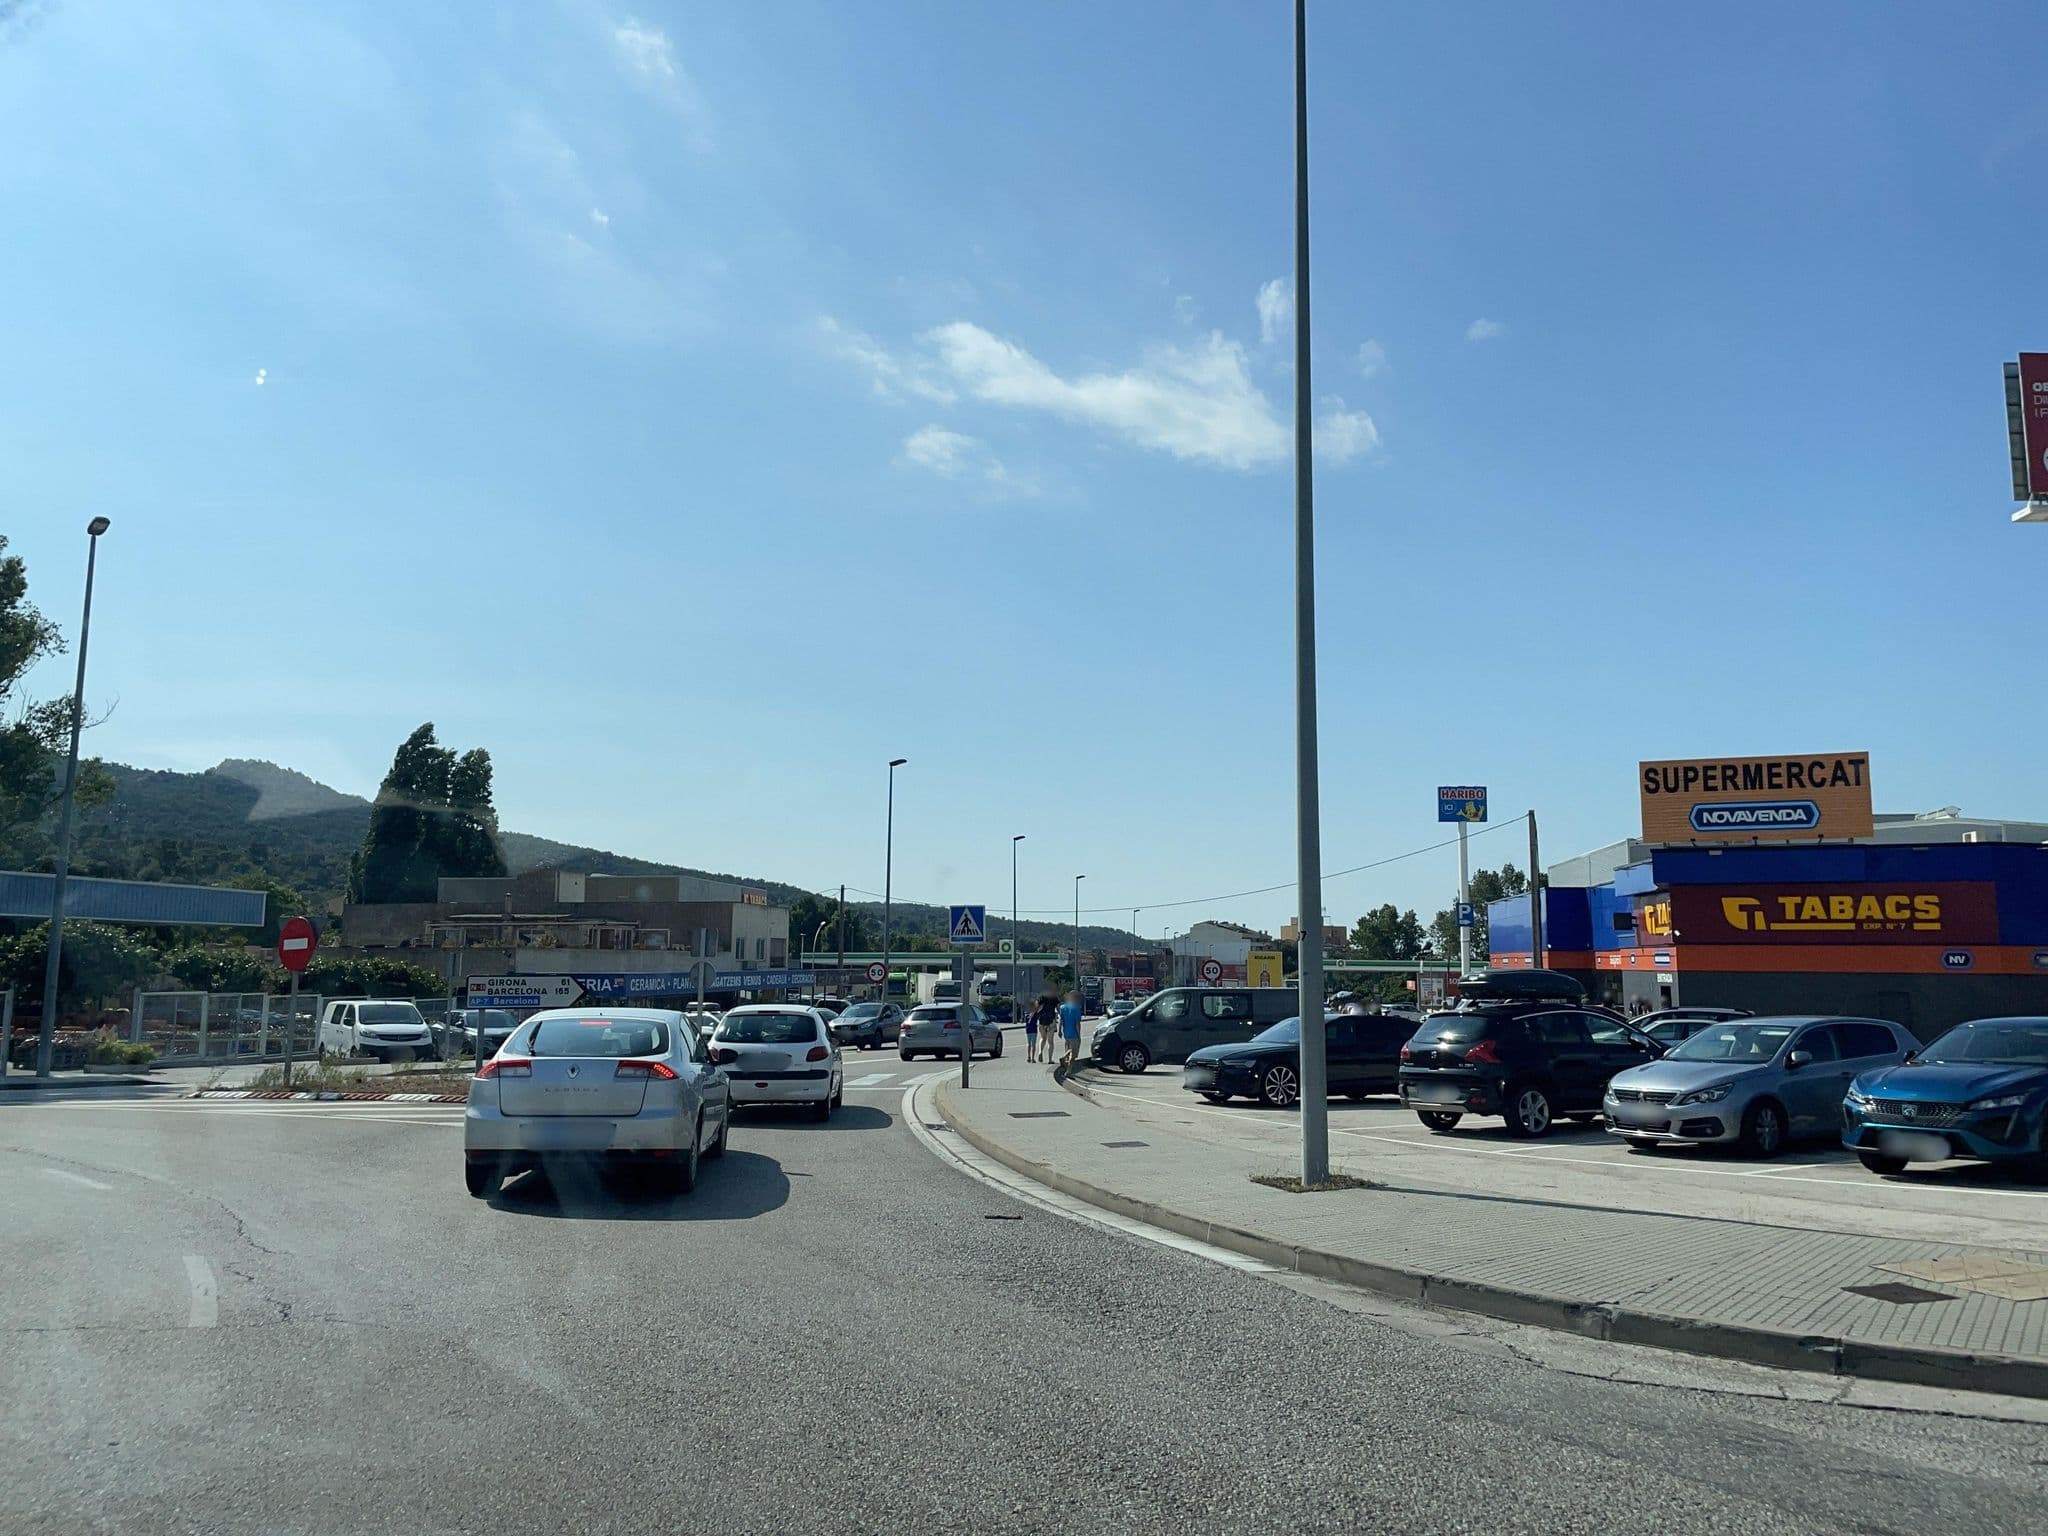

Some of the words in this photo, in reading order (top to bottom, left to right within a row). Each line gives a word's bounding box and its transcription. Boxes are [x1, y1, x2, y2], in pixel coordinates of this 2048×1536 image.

[1644, 758, 1865, 794] SUPERMERCAT
[1441, 789, 1485, 799] HARIBO
[1702, 808, 1807, 824] NOVAVENDA
[1459, 904, 1471, 920] P
[1778, 895, 1941, 920] TABACS
[1949, 955, 1966, 964] NV
[871, 968, 883, 977] 50
[1205, 966, 1219, 975] 50
[561, 978, 570, 986] 61
[555, 987, 570, 995] 165
[493, 997, 539, 1005] Barcelona
